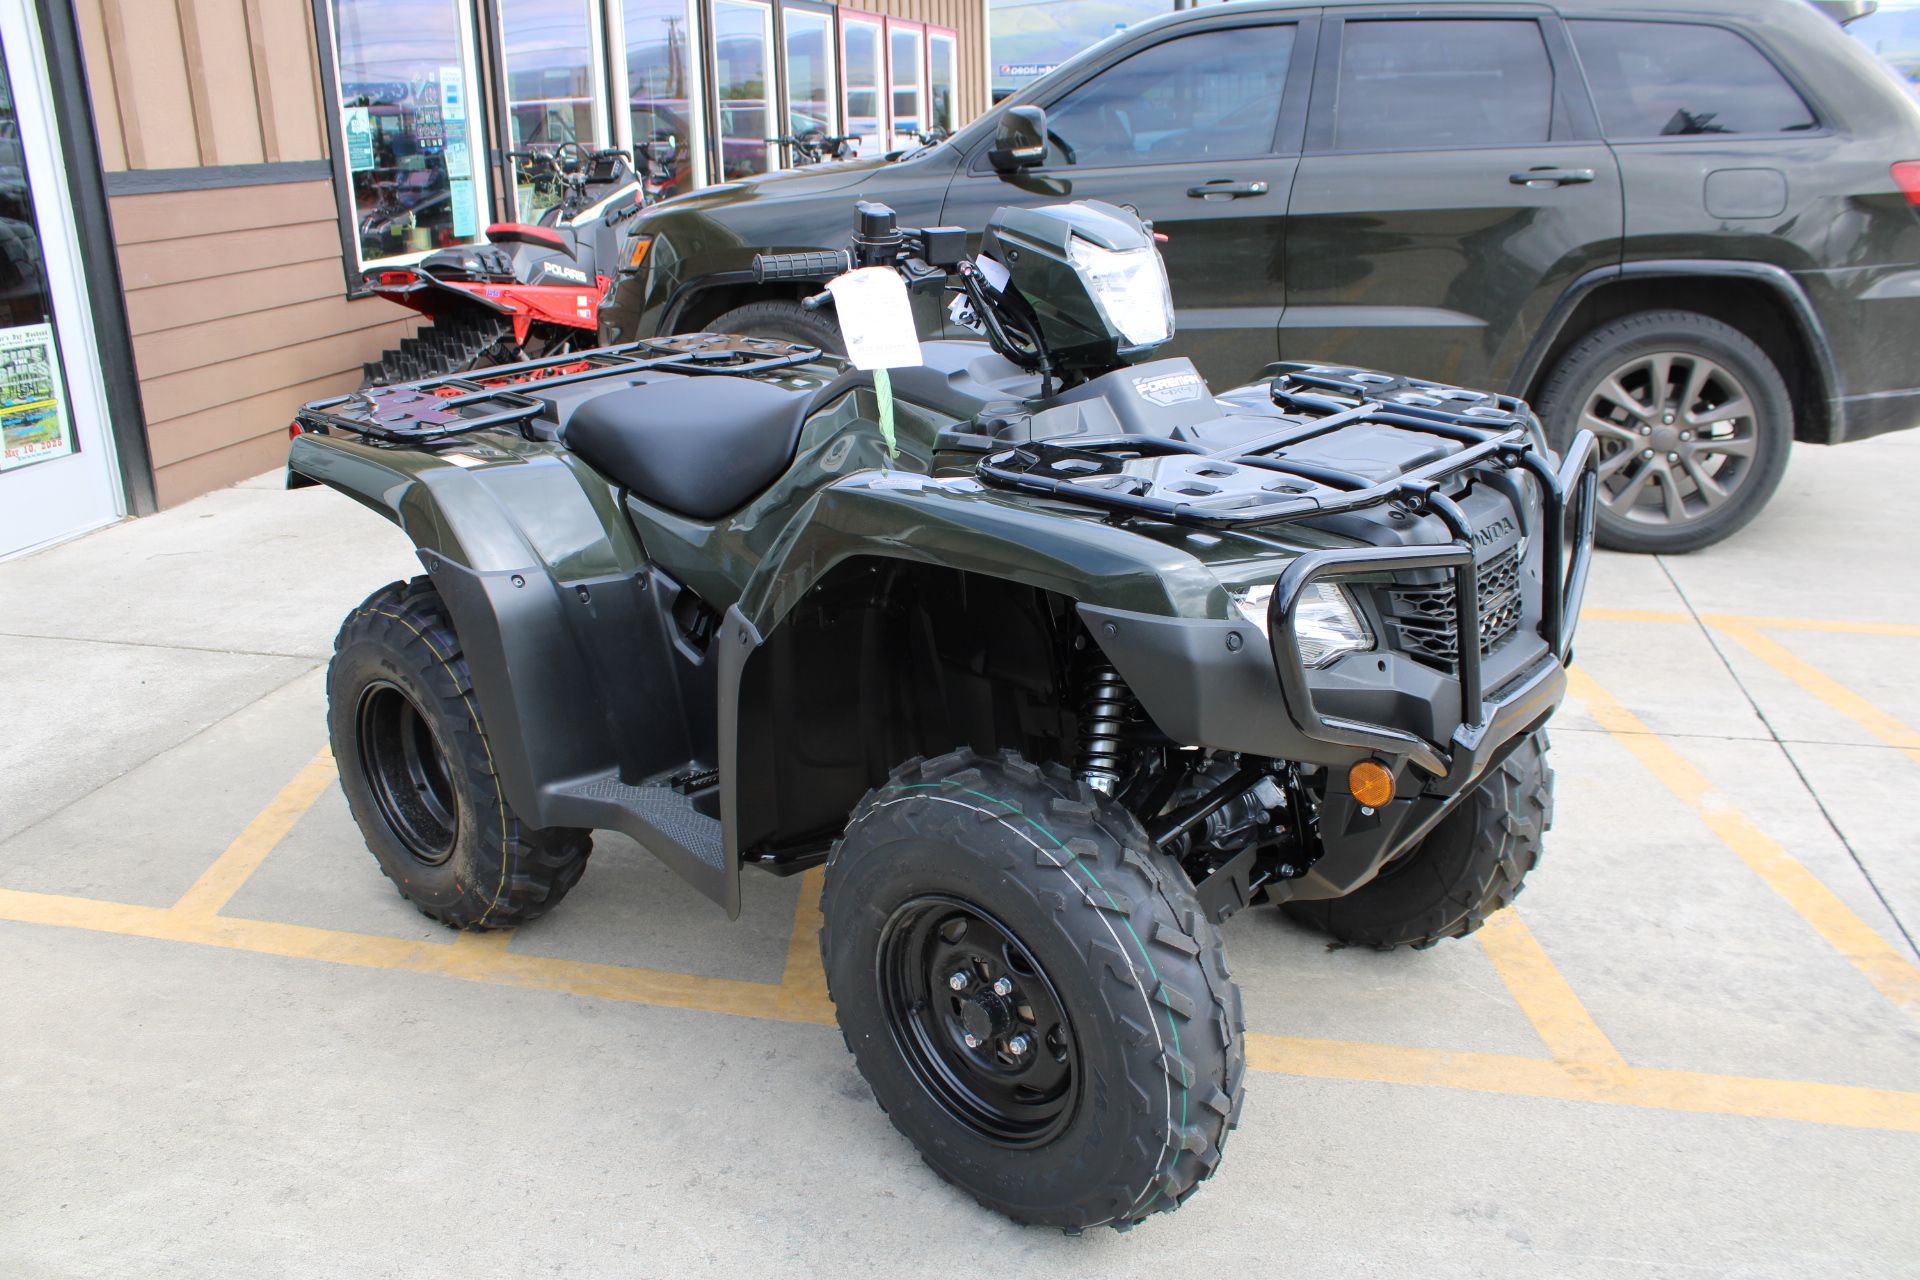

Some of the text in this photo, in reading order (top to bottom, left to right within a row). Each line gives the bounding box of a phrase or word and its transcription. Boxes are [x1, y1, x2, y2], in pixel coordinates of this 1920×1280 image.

[543, 261, 588, 284] POLARIS
[1135, 374, 1201, 395] FOREMAN
[4, 448, 20, 459] May
[40, 438, 63, 450] 2025
